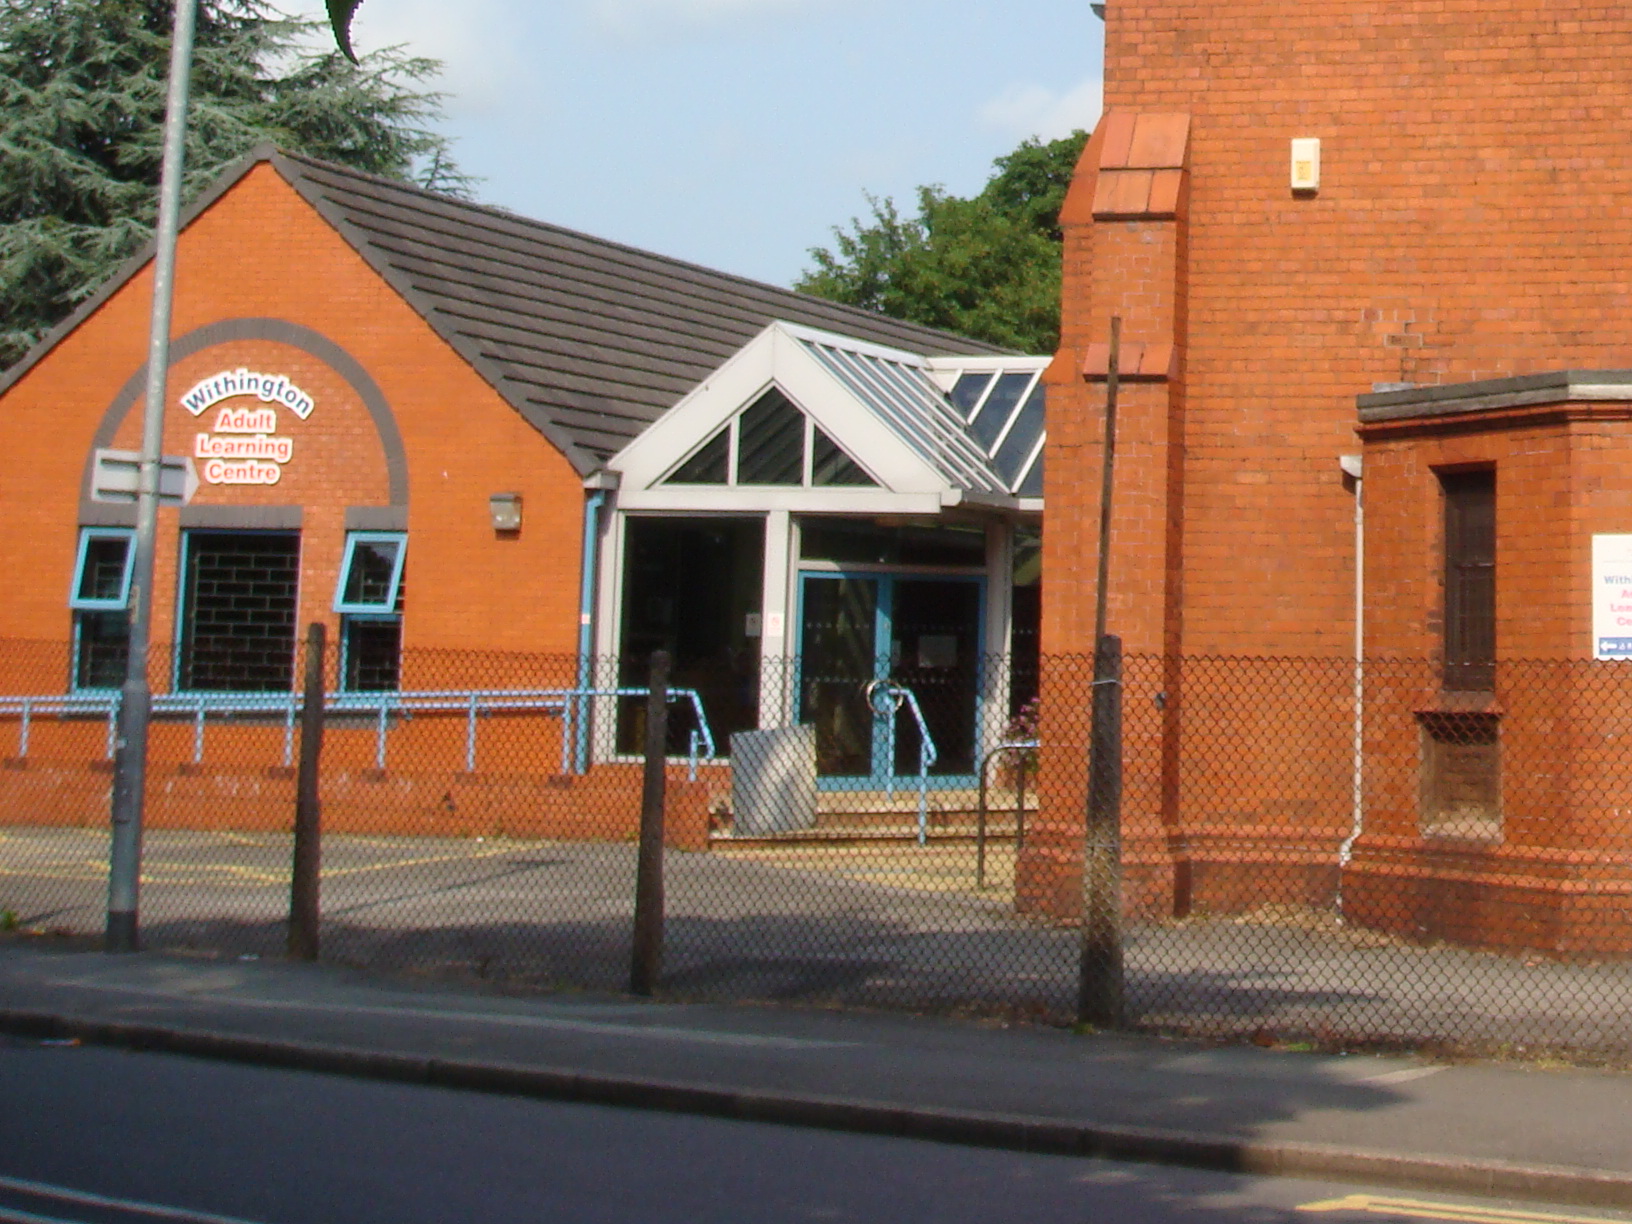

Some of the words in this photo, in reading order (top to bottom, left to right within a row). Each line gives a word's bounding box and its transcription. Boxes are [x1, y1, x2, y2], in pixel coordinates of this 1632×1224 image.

[185, 372, 311, 415] Withington
[218, 412, 274, 429] Adult
[199, 437, 290, 458] Learning
[208, 463, 278, 481] Centre
